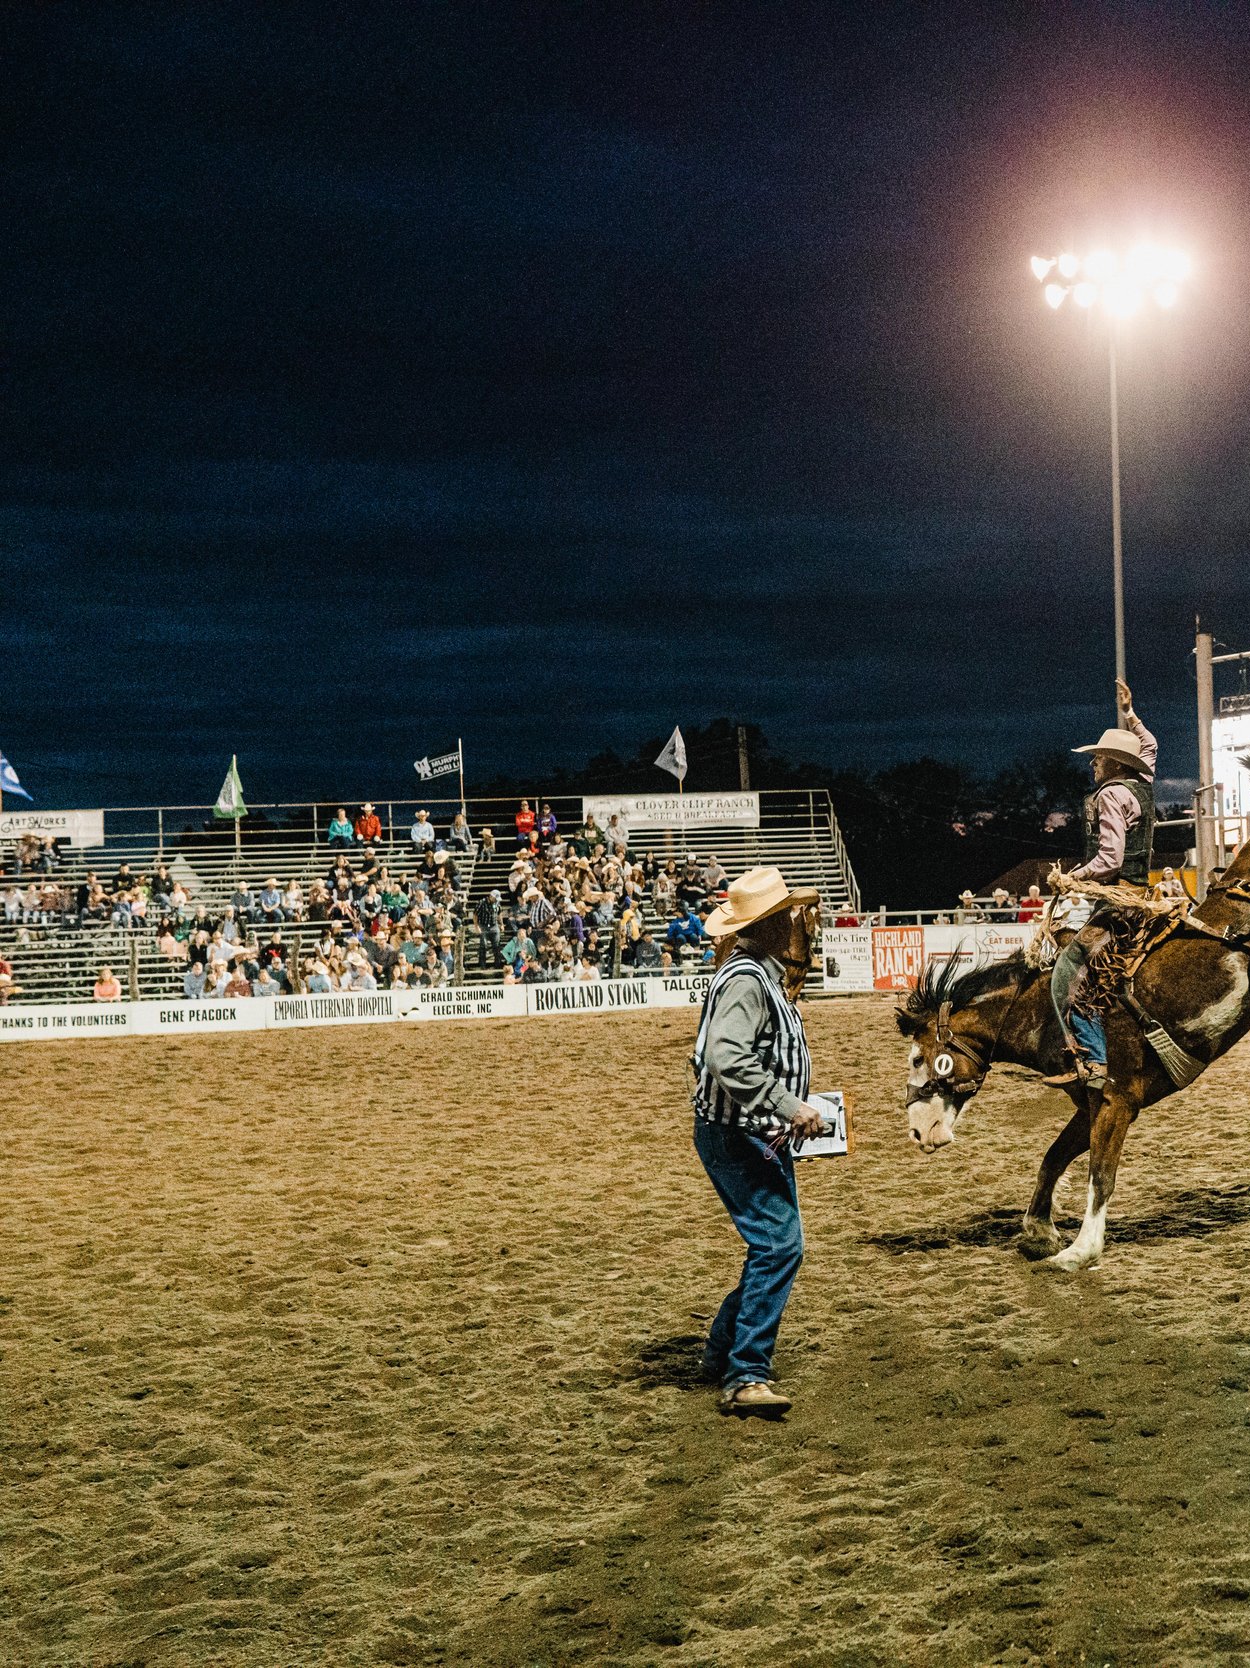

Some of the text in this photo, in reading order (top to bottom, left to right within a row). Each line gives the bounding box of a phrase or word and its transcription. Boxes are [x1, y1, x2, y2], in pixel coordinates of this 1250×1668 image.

[431, 755, 460, 768] MURPH
[635, 800, 679, 811] CLOVER
[716, 798, 754, 809] RANCH
[826, 933, 869, 943] Mel's Tire
[875, 931, 921, 948] HIGHLAND
[989, 937, 1023, 945] EAT BEEF
[875, 947, 922, 979] RANCH
[663, 977, 710, 991] TALLGR
[420, 989, 504, 1003] GERALD SCHUMANN
[535, 982, 648, 1011] ROCKLAND STONE
[689, 991, 697, 1003] &
[274, 996, 393, 1020] EMPORIA VETERINARY HOSPITAL
[477, 1003, 492, 1014] INC
[0, 1014, 127, 1029] HANKS TO THE VOLUNTEERS
[160, 1008, 237, 1023] GENE PEACOCK
